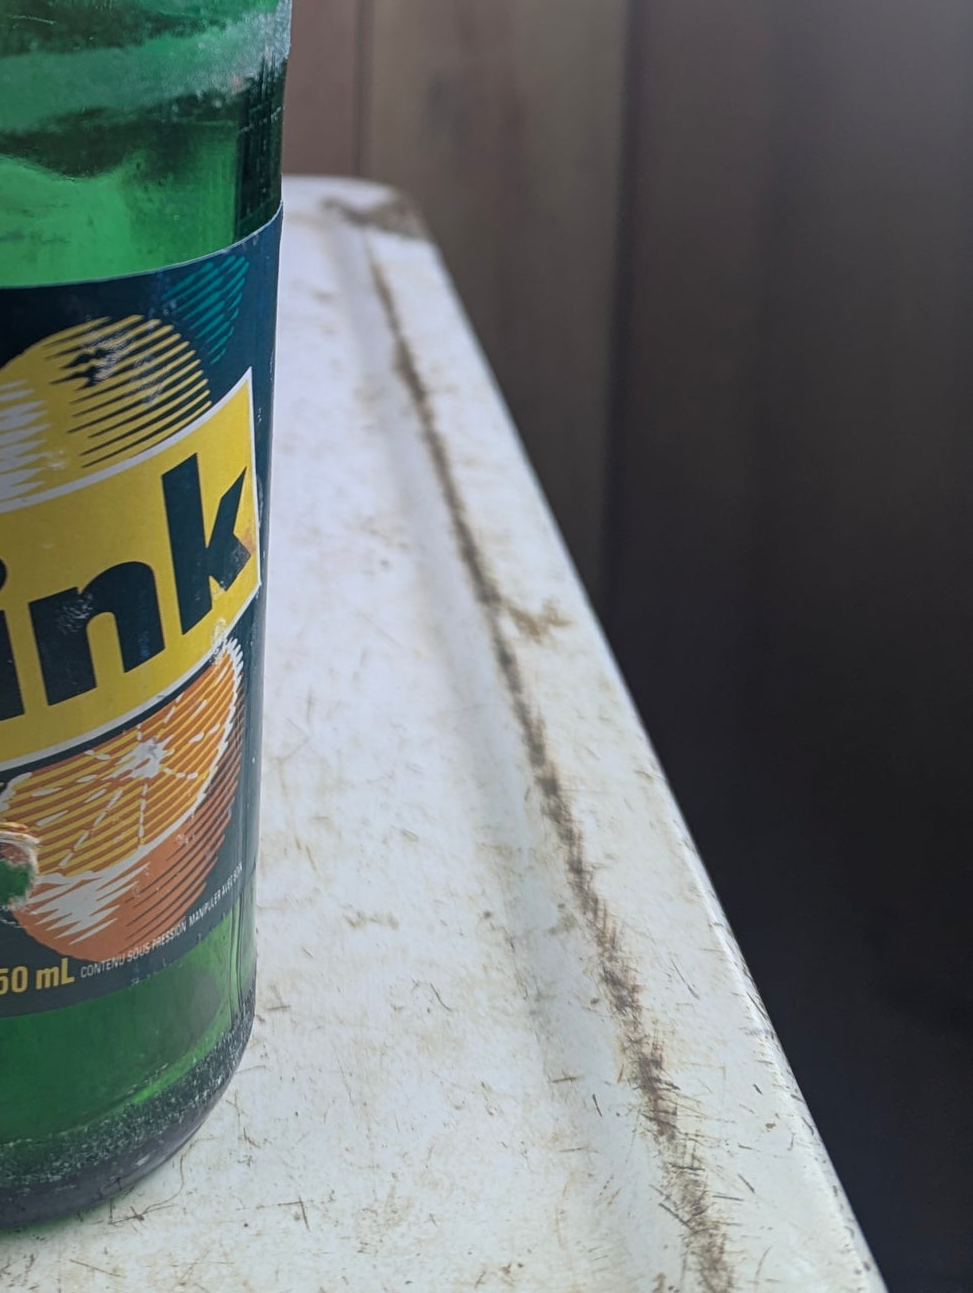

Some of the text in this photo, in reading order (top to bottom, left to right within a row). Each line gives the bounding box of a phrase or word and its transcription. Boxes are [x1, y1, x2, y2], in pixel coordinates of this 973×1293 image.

[80, 955, 125, 978] CONTENU
[127, 941, 151, 962] SOUS
[151, 920, 187, 950] PRESSION
[36, 958, 75, 991] mL
